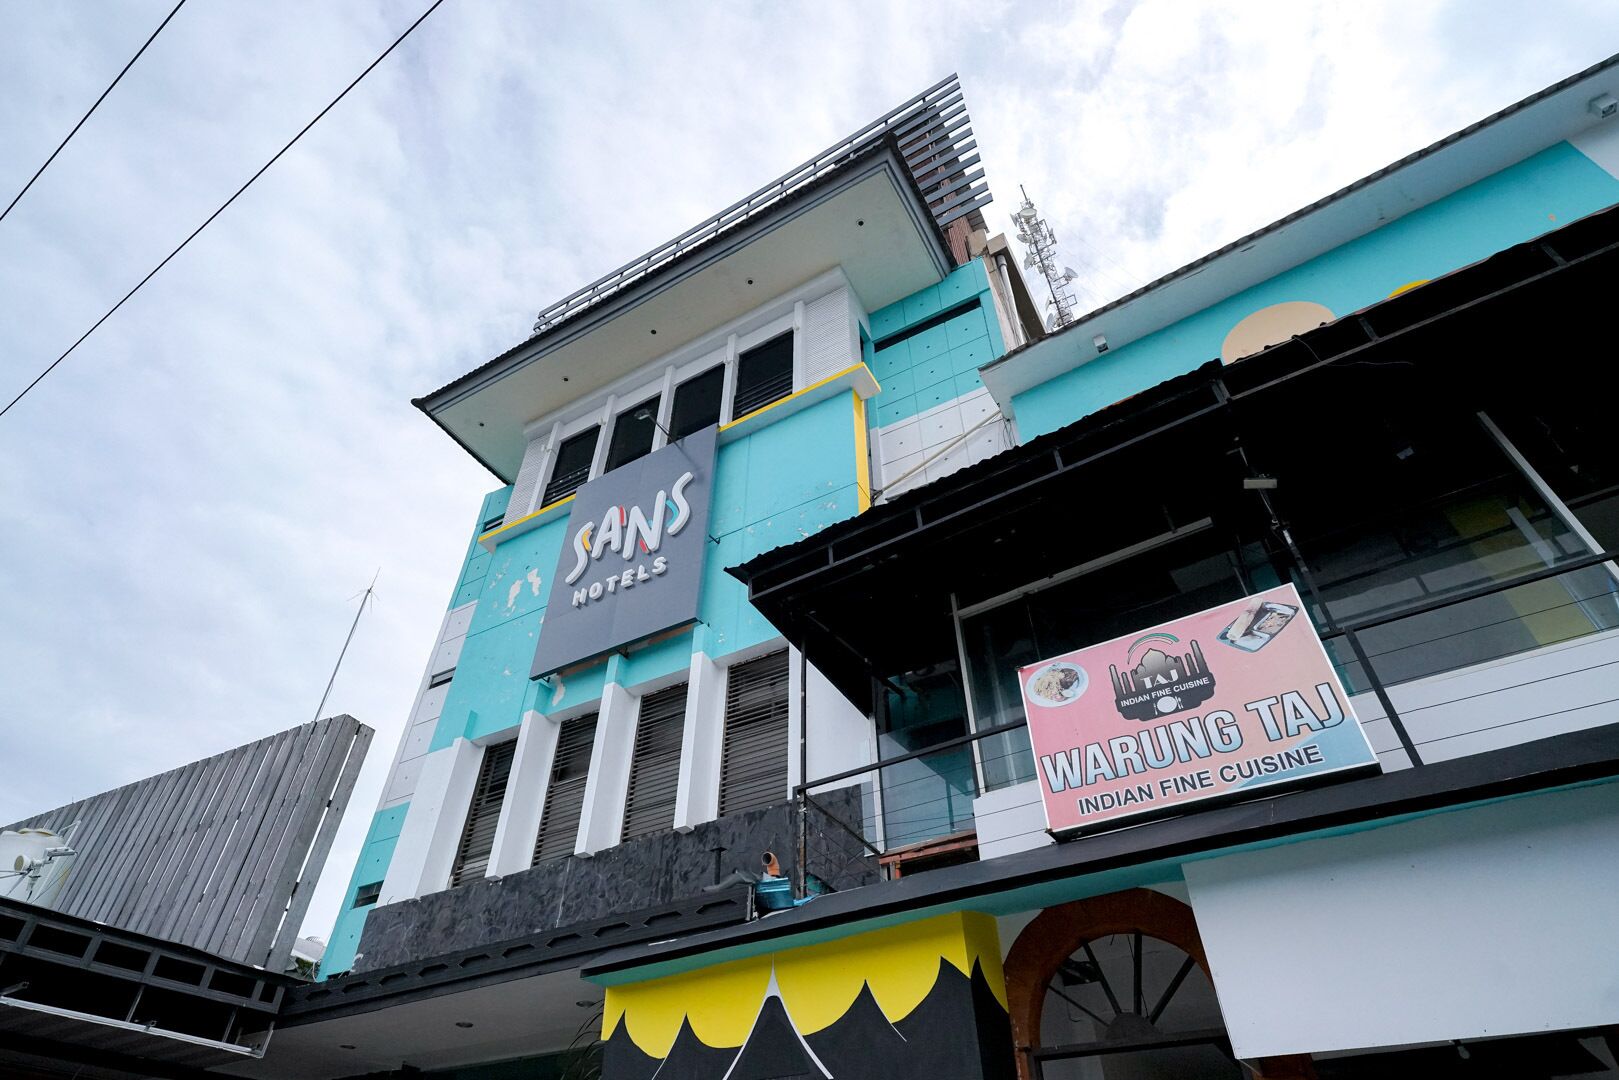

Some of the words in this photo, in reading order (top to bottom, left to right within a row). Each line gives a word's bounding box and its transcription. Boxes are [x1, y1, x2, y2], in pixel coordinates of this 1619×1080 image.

[565, 471, 694, 585] SANS
[572, 556, 667, 607] HOTELS
[1120, 693, 1150, 707] INDIAN
[1151, 687, 1172, 699] FINE
[1173, 677, 1210, 693] CUISINE
[1140, 669, 1179, 689] TAJ
[1040, 709, 1244, 793] WARUNG
[1245, 682, 1345, 742] TAJ
[1078, 784, 1154, 815] INDIAN
[1161, 770, 1214, 795] FINE
[1219, 745, 1324, 783] CUISINE
